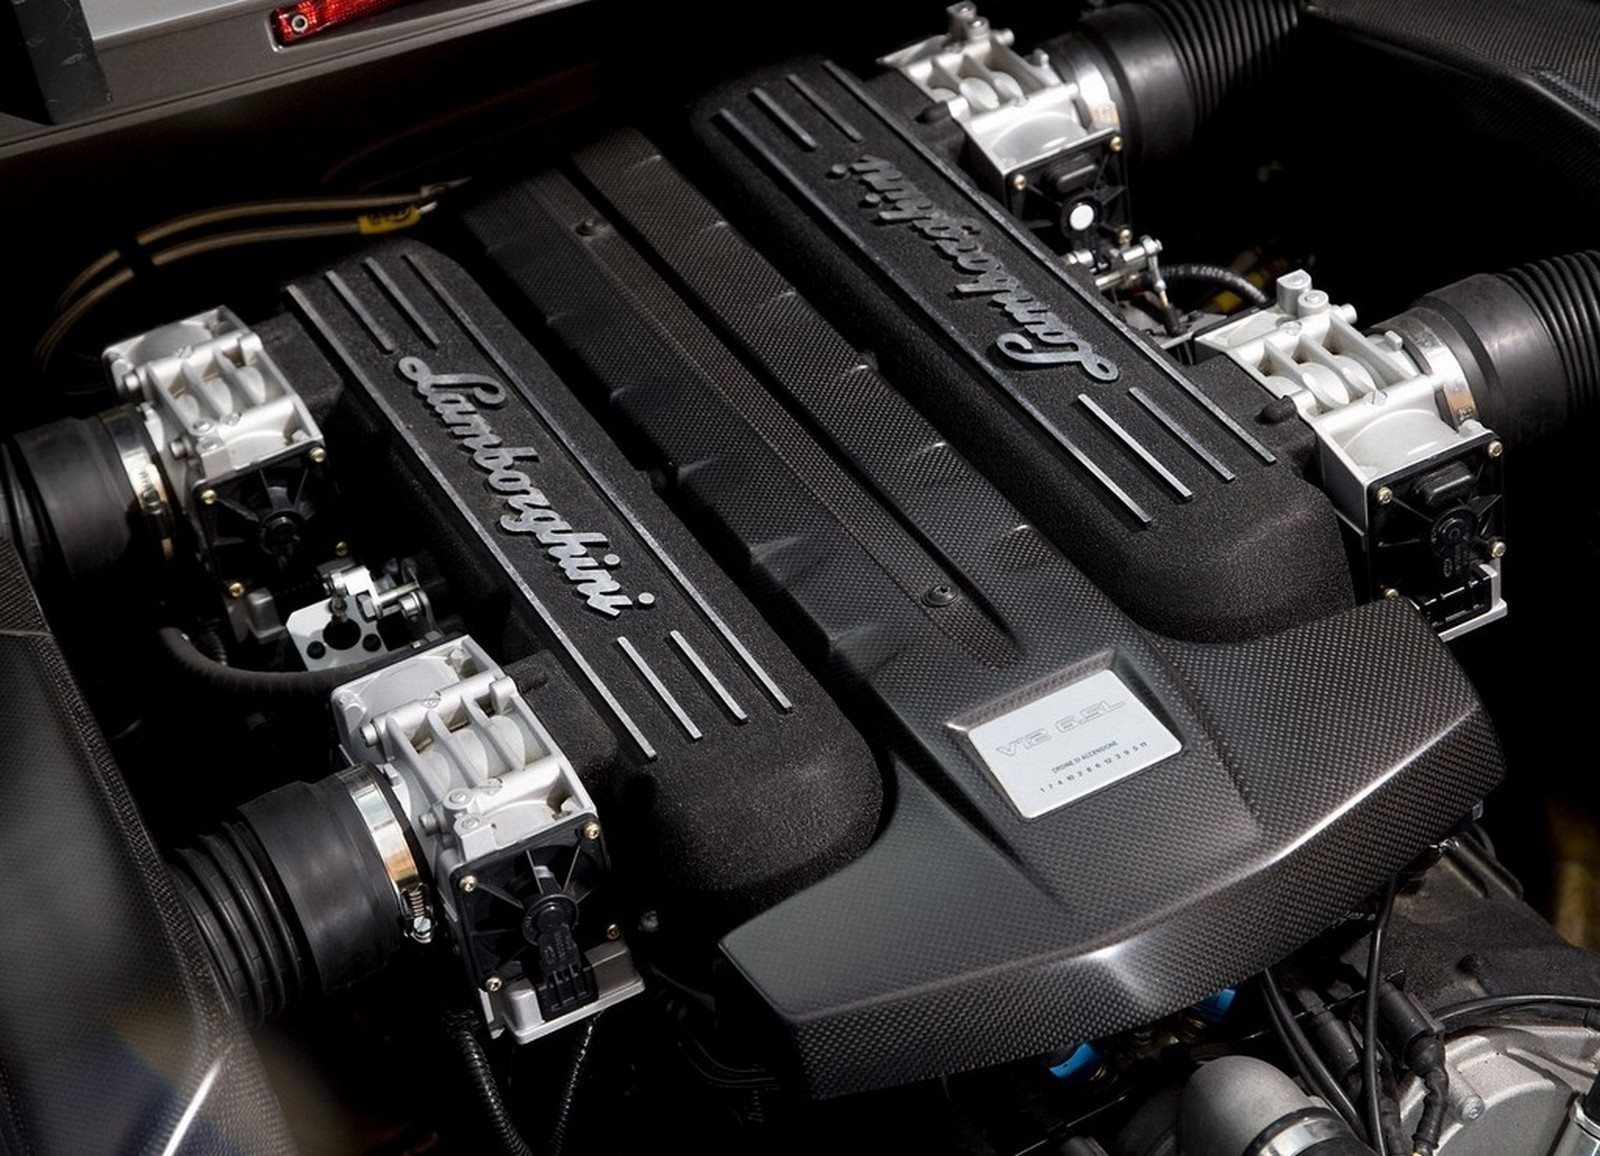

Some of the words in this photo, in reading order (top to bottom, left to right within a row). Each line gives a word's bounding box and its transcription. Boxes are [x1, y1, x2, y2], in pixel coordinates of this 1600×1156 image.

[827, 155, 1119, 384] Lamborghini
[394, 355, 655, 620] Lamborghini
[995, 728, 1053, 757] V12
[1052, 761, 1074, 773] ORDINE
[1081, 741, 1118, 760] ACCENSIONE
